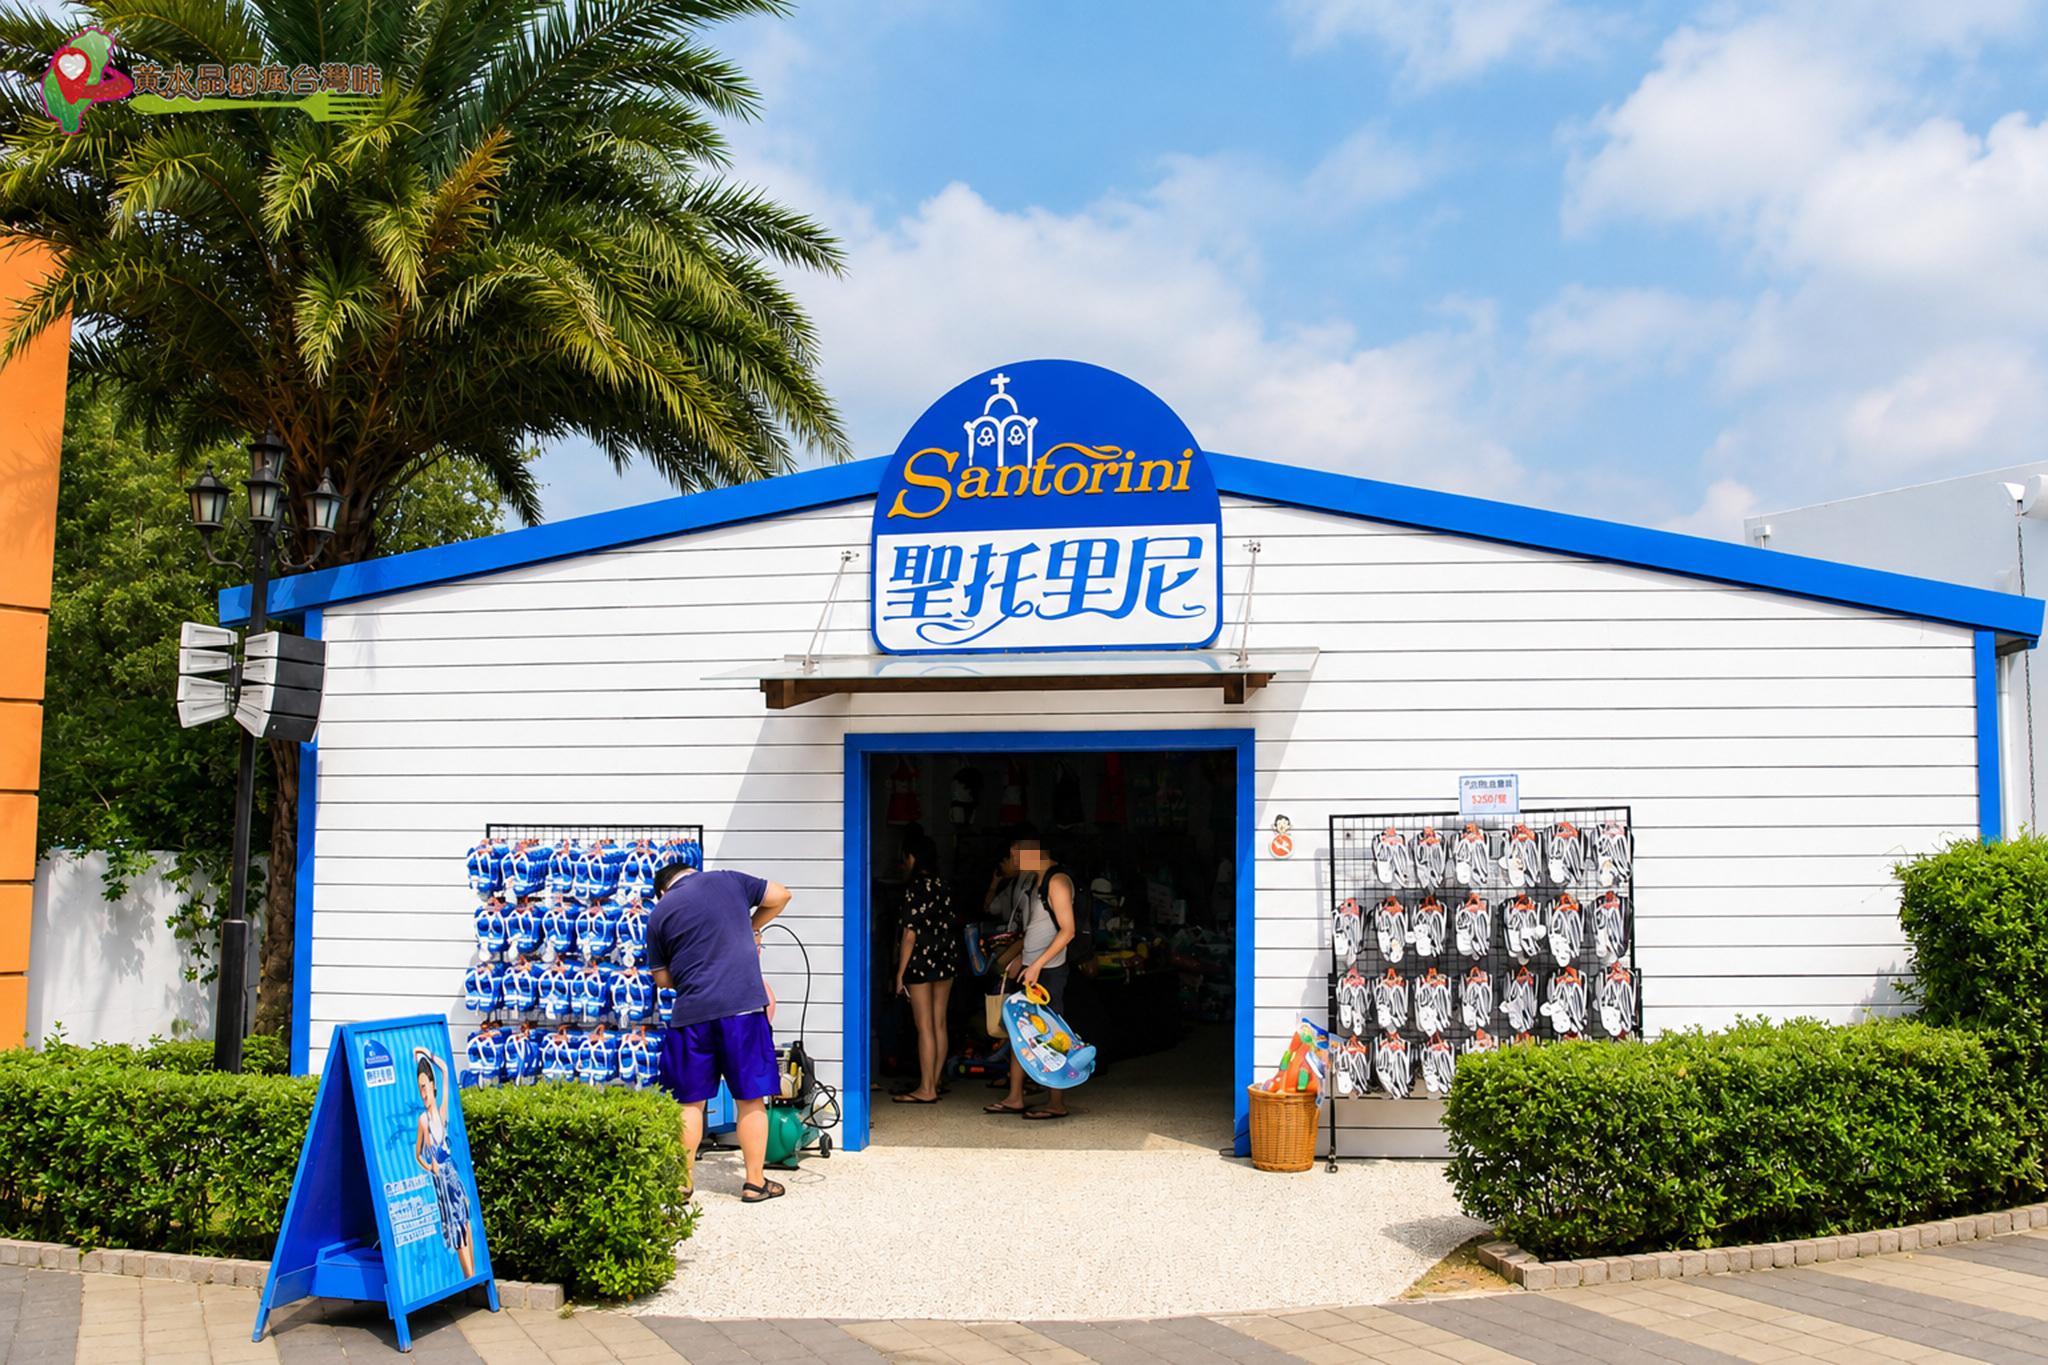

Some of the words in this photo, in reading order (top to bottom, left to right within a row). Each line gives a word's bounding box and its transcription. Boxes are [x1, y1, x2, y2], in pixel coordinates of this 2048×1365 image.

[886, 442, 1195, 519] Santorini
[883, 536, 1207, 645] 聖托里尼
